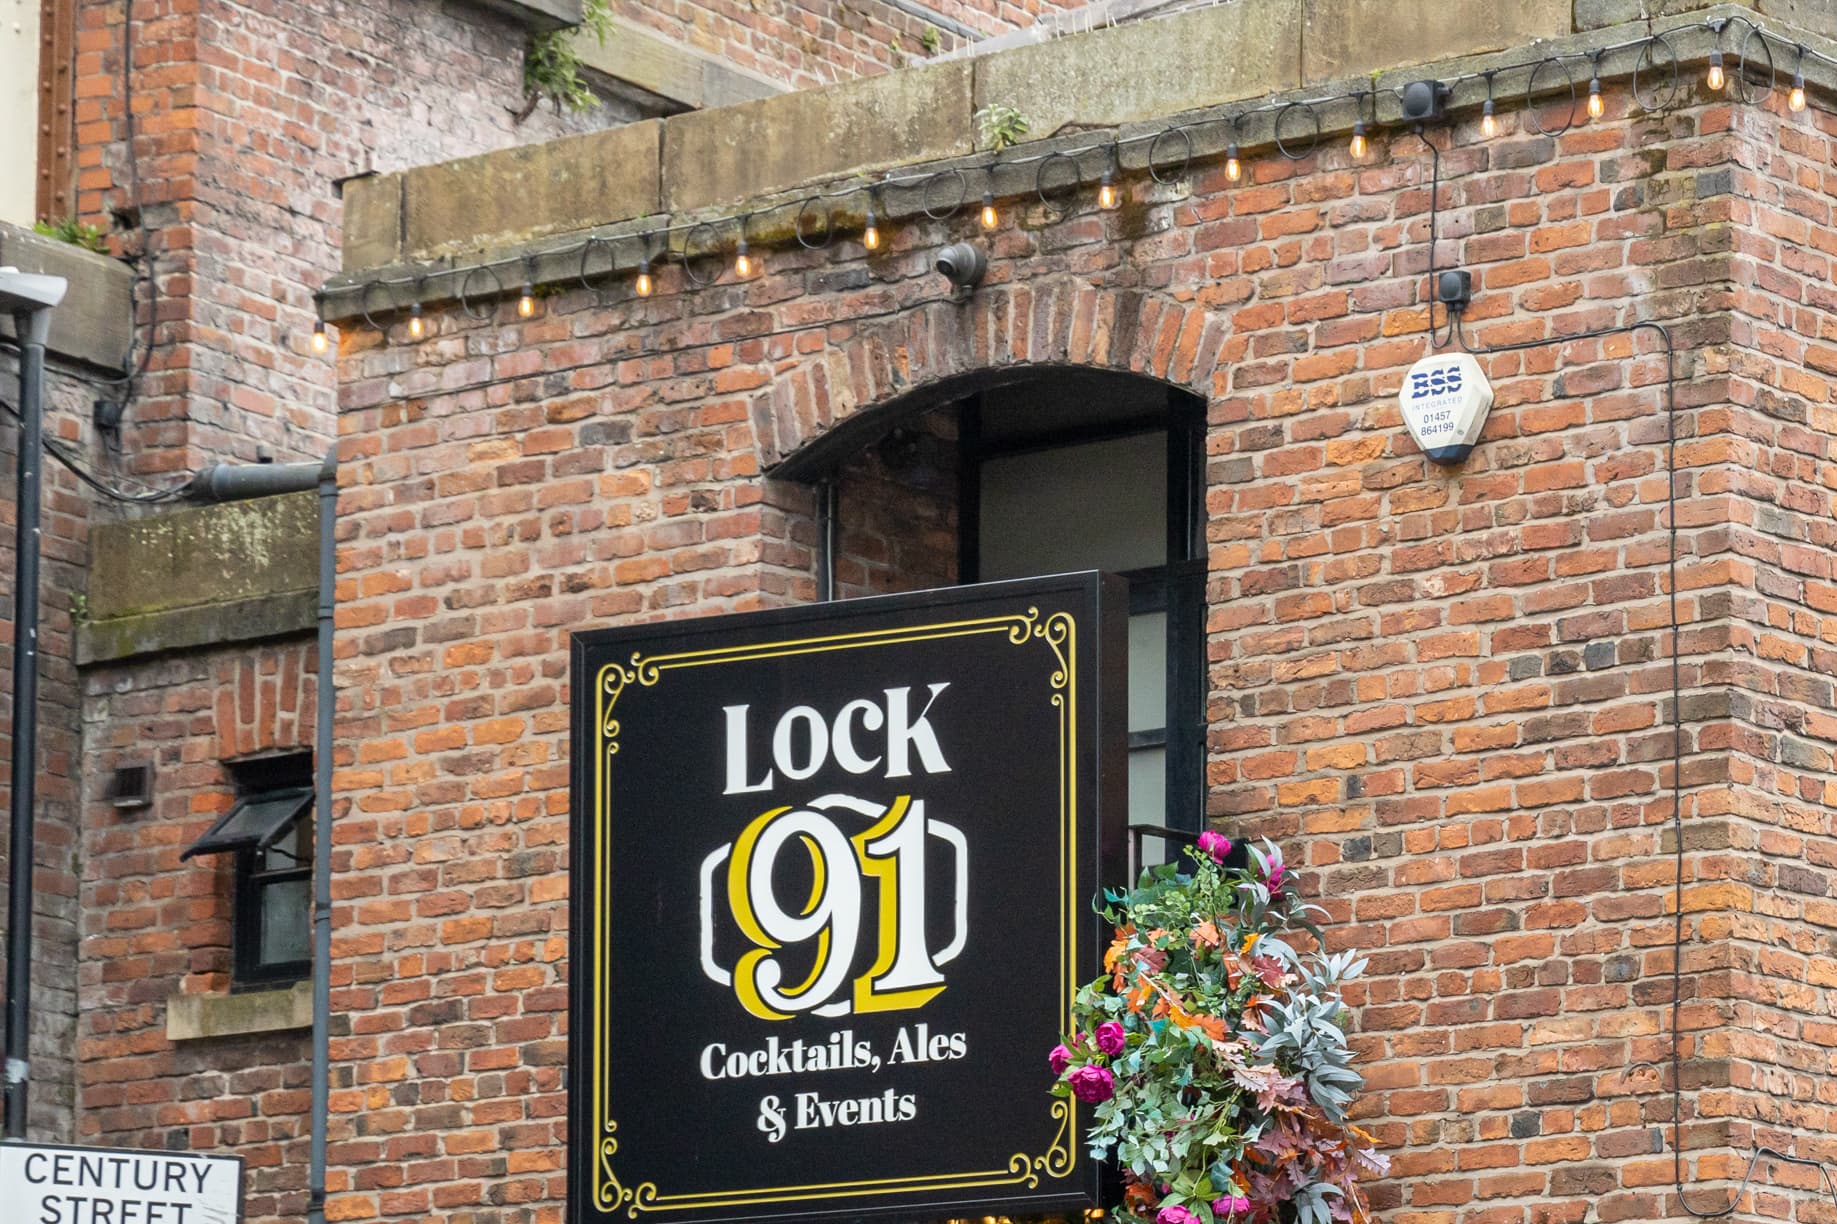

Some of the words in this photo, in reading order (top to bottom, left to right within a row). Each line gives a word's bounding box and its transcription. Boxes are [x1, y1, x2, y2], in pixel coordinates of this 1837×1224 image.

[1412, 366, 1462, 399] BSS
[1412, 396, 1463, 411] INTEGRATED
[1424, 410, 1451, 424] 01457
[1421, 422, 1454, 436] 864199
[728, 794, 947, 1021] 91
[700, 1030, 882, 1081] Cocktails,
[887, 1023, 968, 1065] Ales
[756, 1094, 788, 1143] &
[794, 1086, 917, 1131] Events
[24, 1152, 213, 1194] CENTURY
